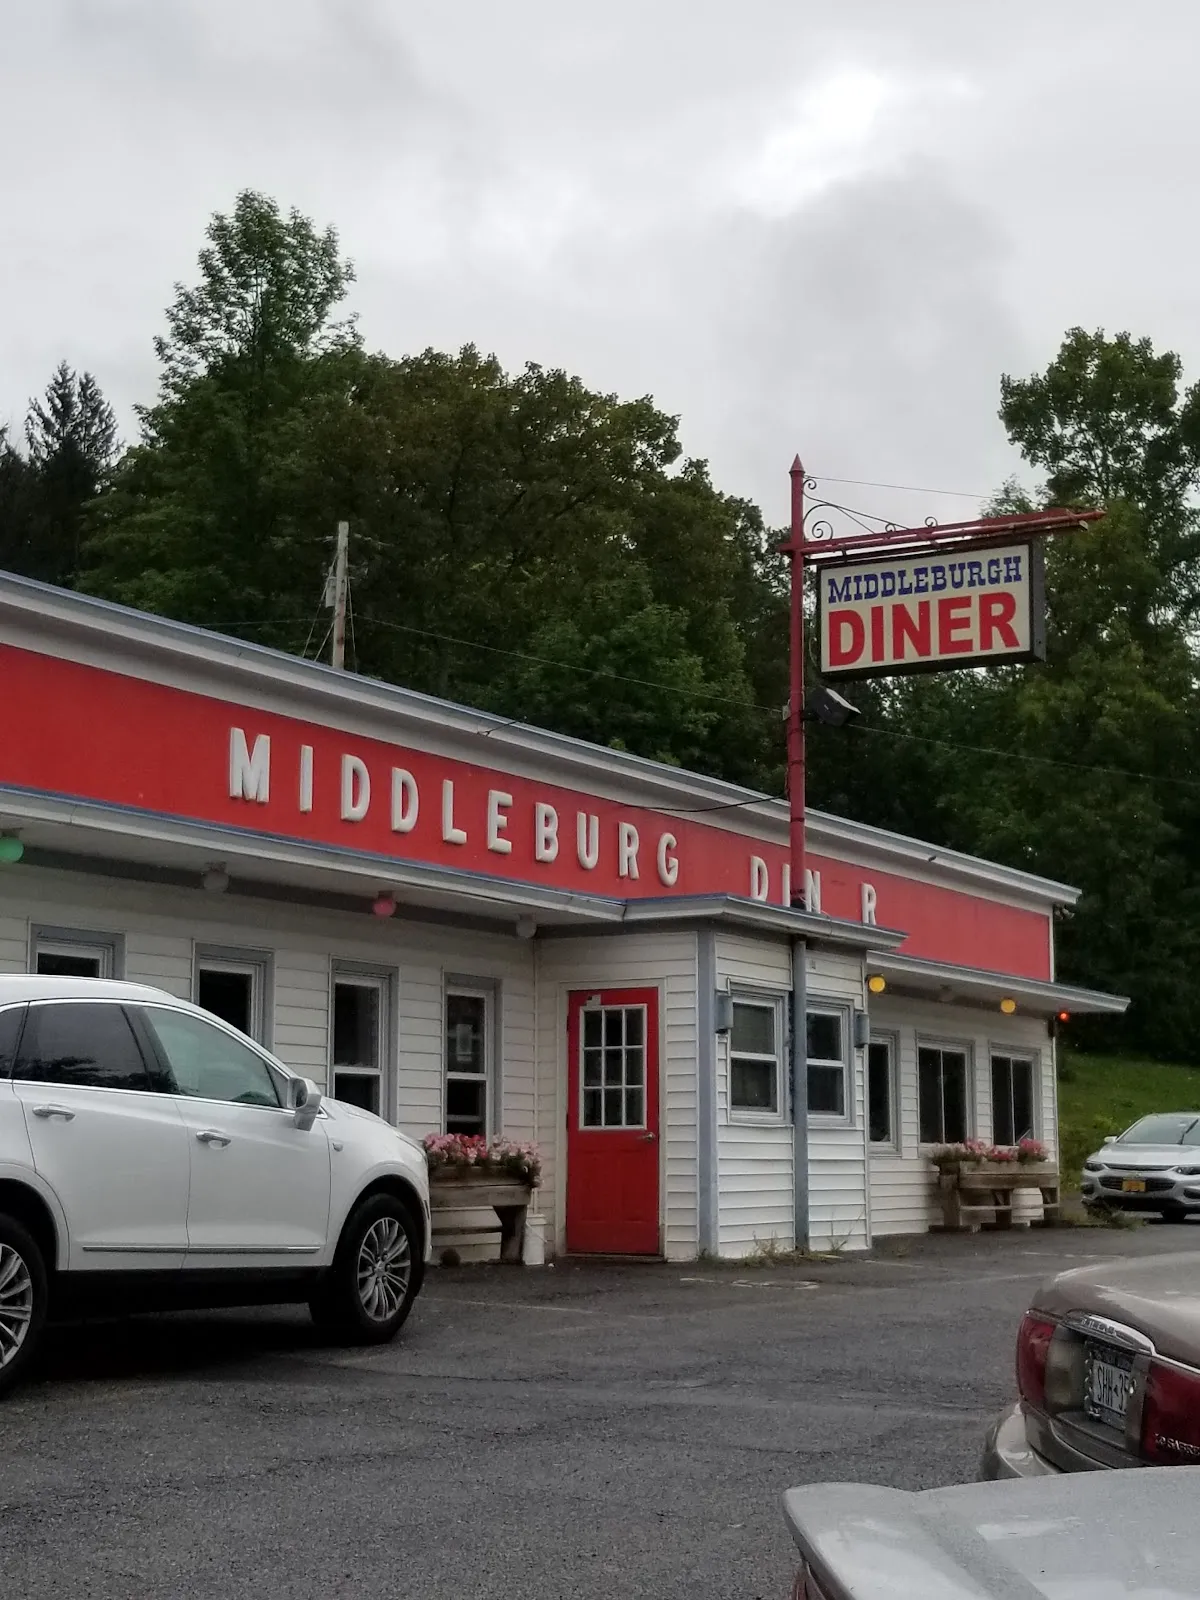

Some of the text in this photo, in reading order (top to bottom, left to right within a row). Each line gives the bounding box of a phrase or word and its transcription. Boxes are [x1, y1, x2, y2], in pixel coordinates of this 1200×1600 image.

[827, 555, 1022, 604] MIDDLEBURGH
[828, 591, 1020, 667] DINER
[229, 727, 679, 887] MIDDLEBURG
